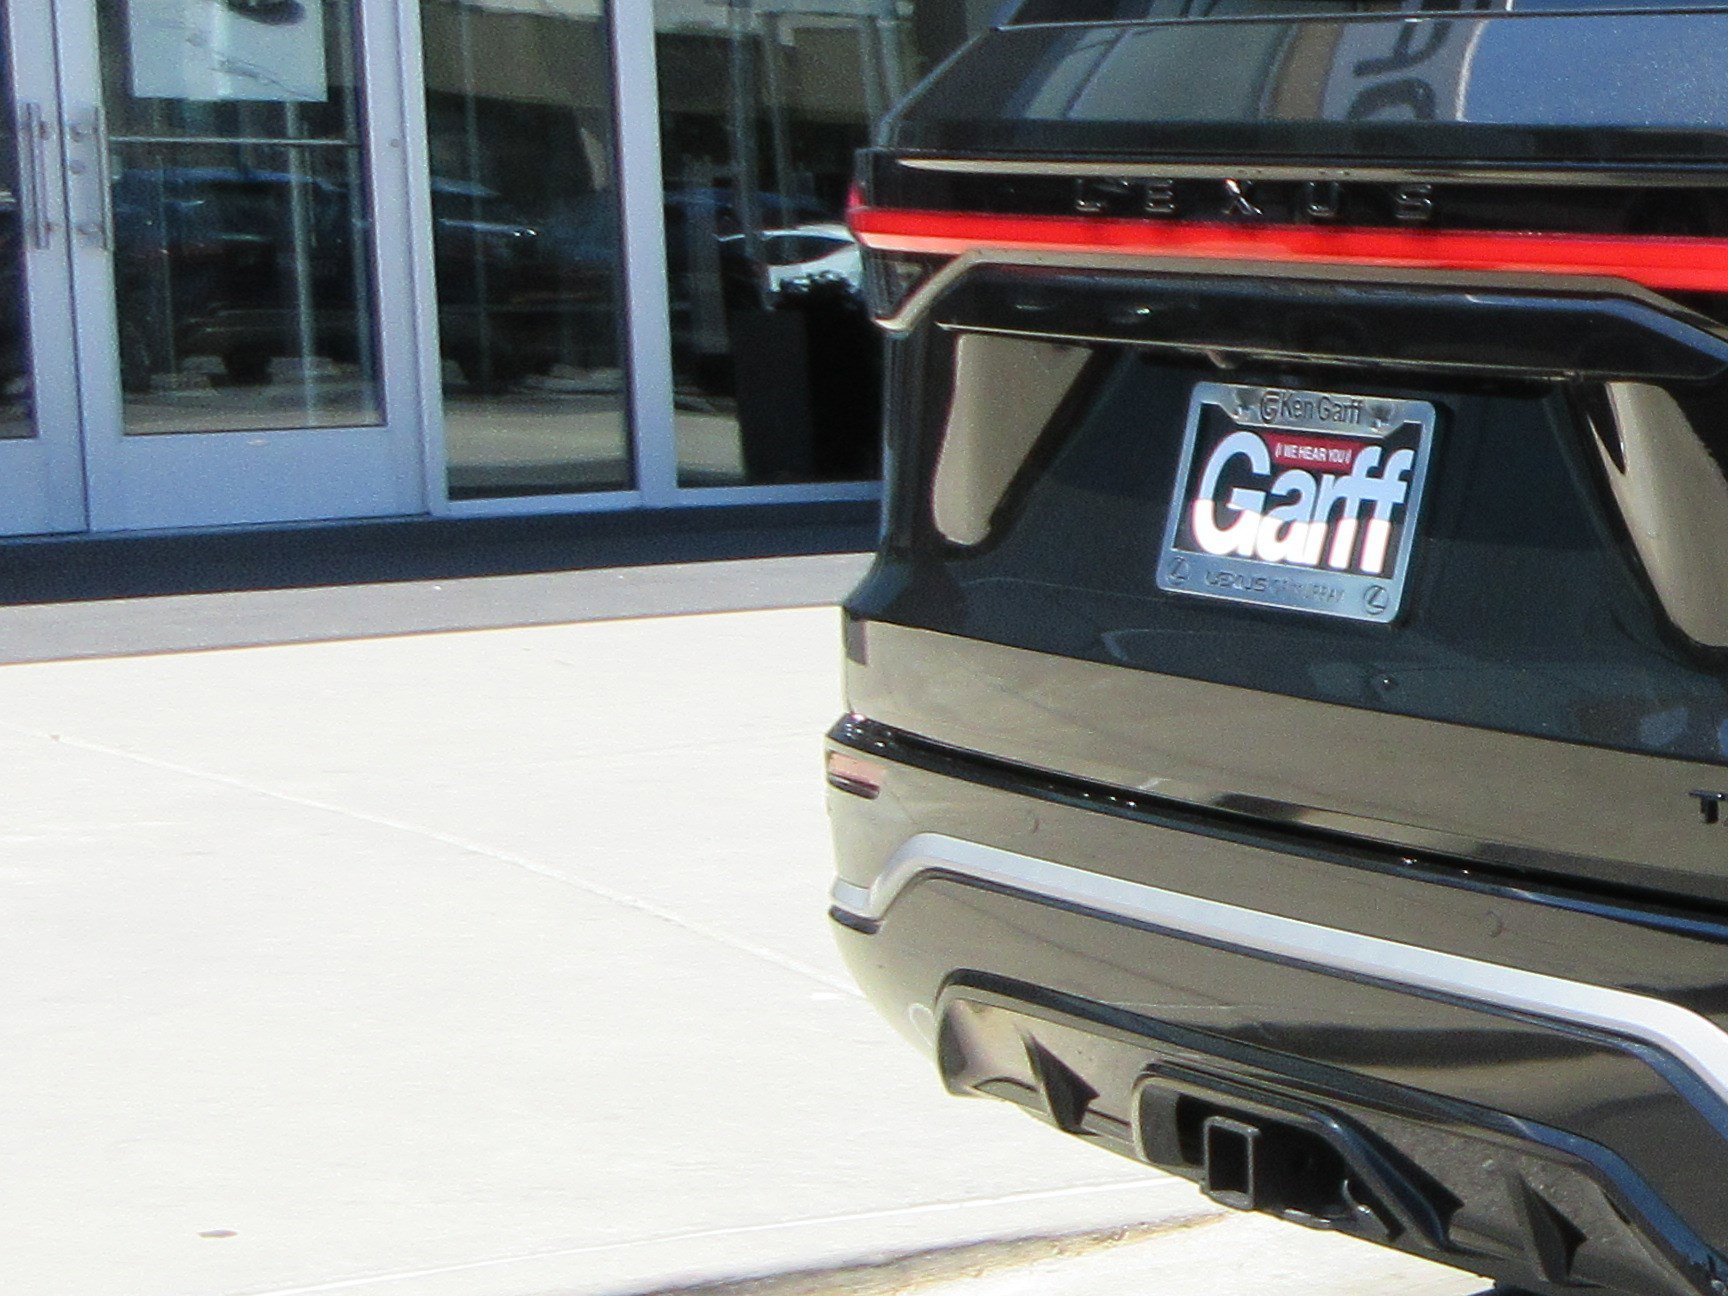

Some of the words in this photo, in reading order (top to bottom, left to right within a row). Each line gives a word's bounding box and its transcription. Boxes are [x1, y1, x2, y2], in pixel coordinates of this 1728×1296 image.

[1075, 176, 1432, 221] LEXUS
[1280, 392, 1314, 419] Ken
[1318, 395, 1363, 424] Garff
[1283, 444, 1298, 459] WE
[1299, 445, 1327, 462] HEAR
[1328, 448, 1346, 464] YOU
[1191, 431, 1415, 574] Garff
[1205, 569, 1267, 592] LEXUS
